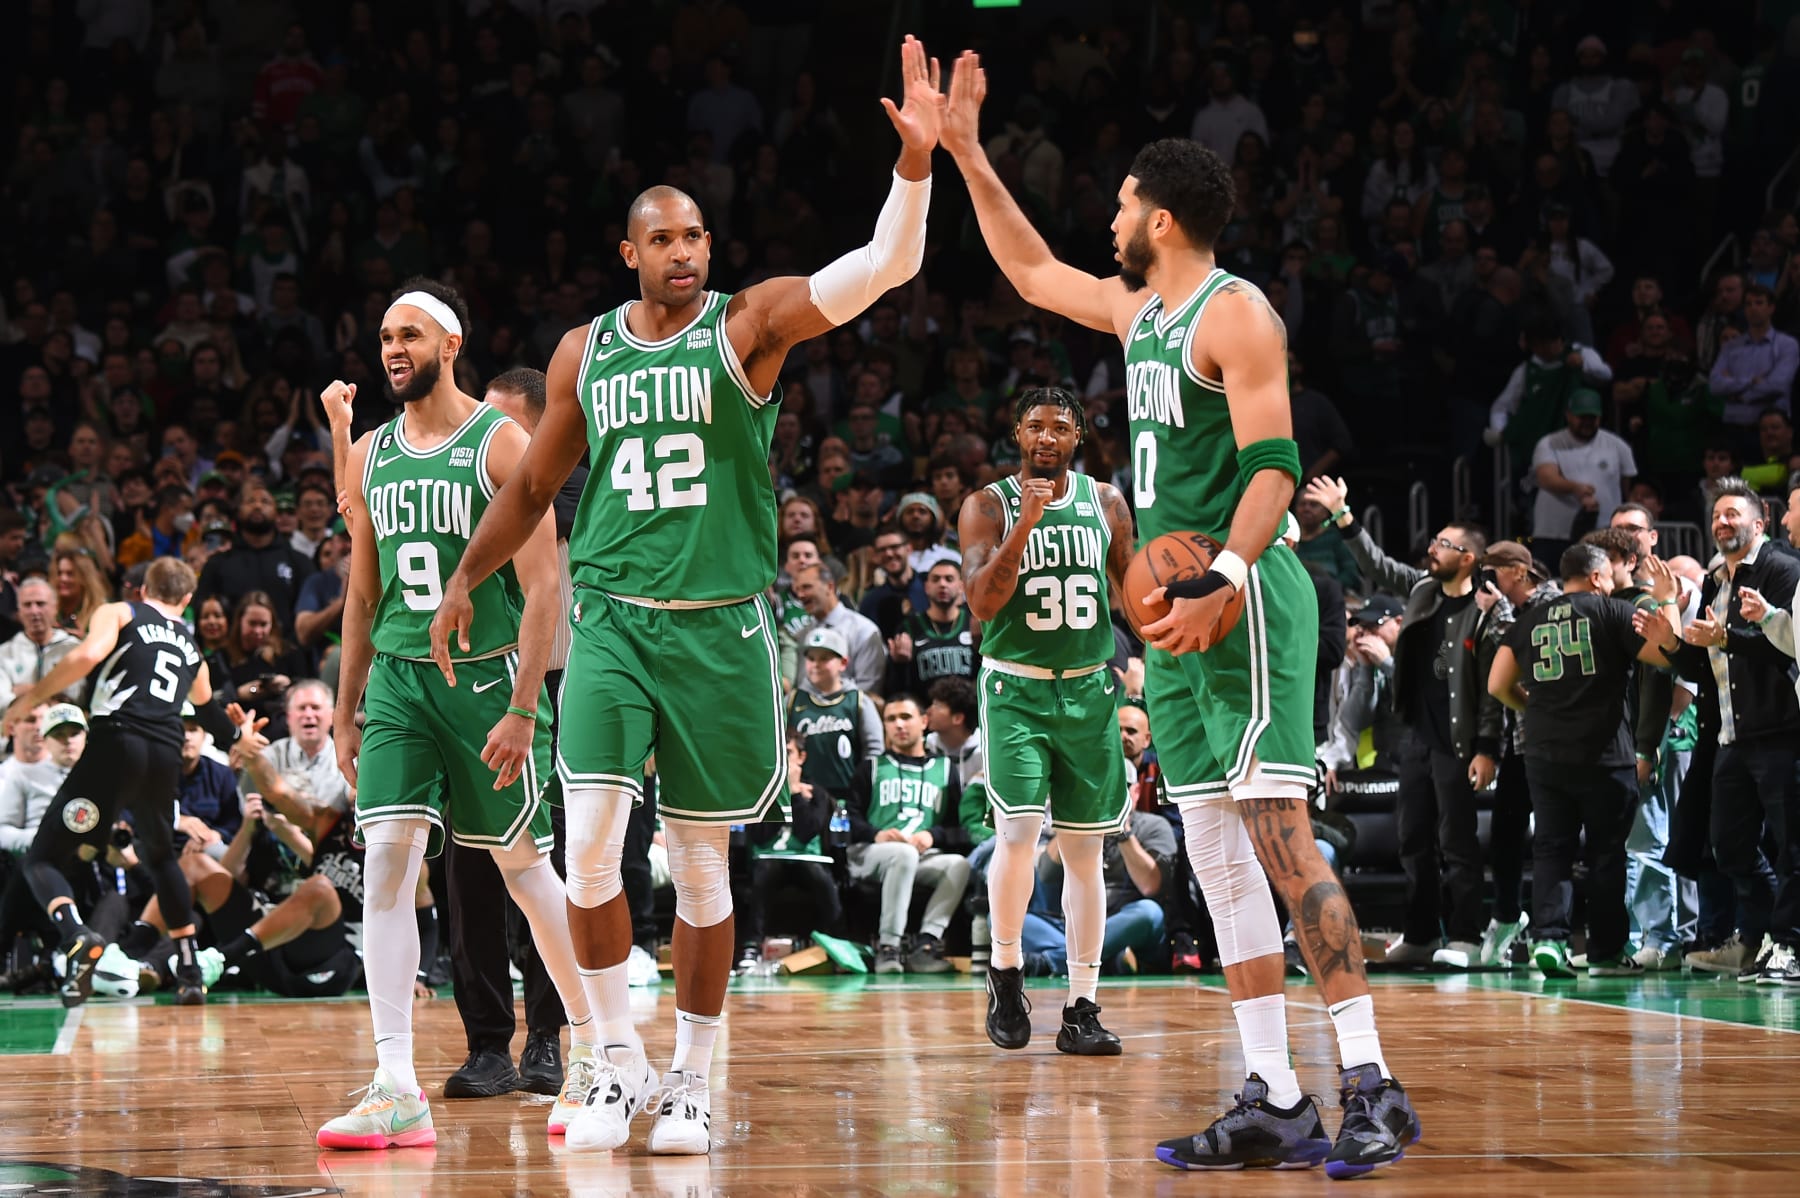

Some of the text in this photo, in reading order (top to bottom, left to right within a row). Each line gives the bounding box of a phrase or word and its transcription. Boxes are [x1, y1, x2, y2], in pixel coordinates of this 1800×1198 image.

[1144, 308, 1158, 321] 6
[601, 331, 613, 345] 6
[686, 328, 712, 342] VISTA
[686, 339, 712, 350] PRINT
[591, 366, 712, 438] BOSTON
[381, 434, 393, 449] 6
[451, 447, 475, 459] VISTA
[448, 458, 473, 467] PRINT
[610, 433, 707, 511] 42
[1135, 431, 1157, 508] 0
[370, 478, 473, 541] BOSTON
[396, 542, 443, 611] 9
[1025, 574, 1098, 631] 36
[917, 646, 972, 681] CELTICS
[1531, 618, 1596, 681] 34
[149, 650, 182, 703] 5
[797, 715, 853, 737] Celtics
[838, 735, 852, 759] 0
[880, 777, 943, 815] BOSTON
[897, 807, 925, 838] 7
